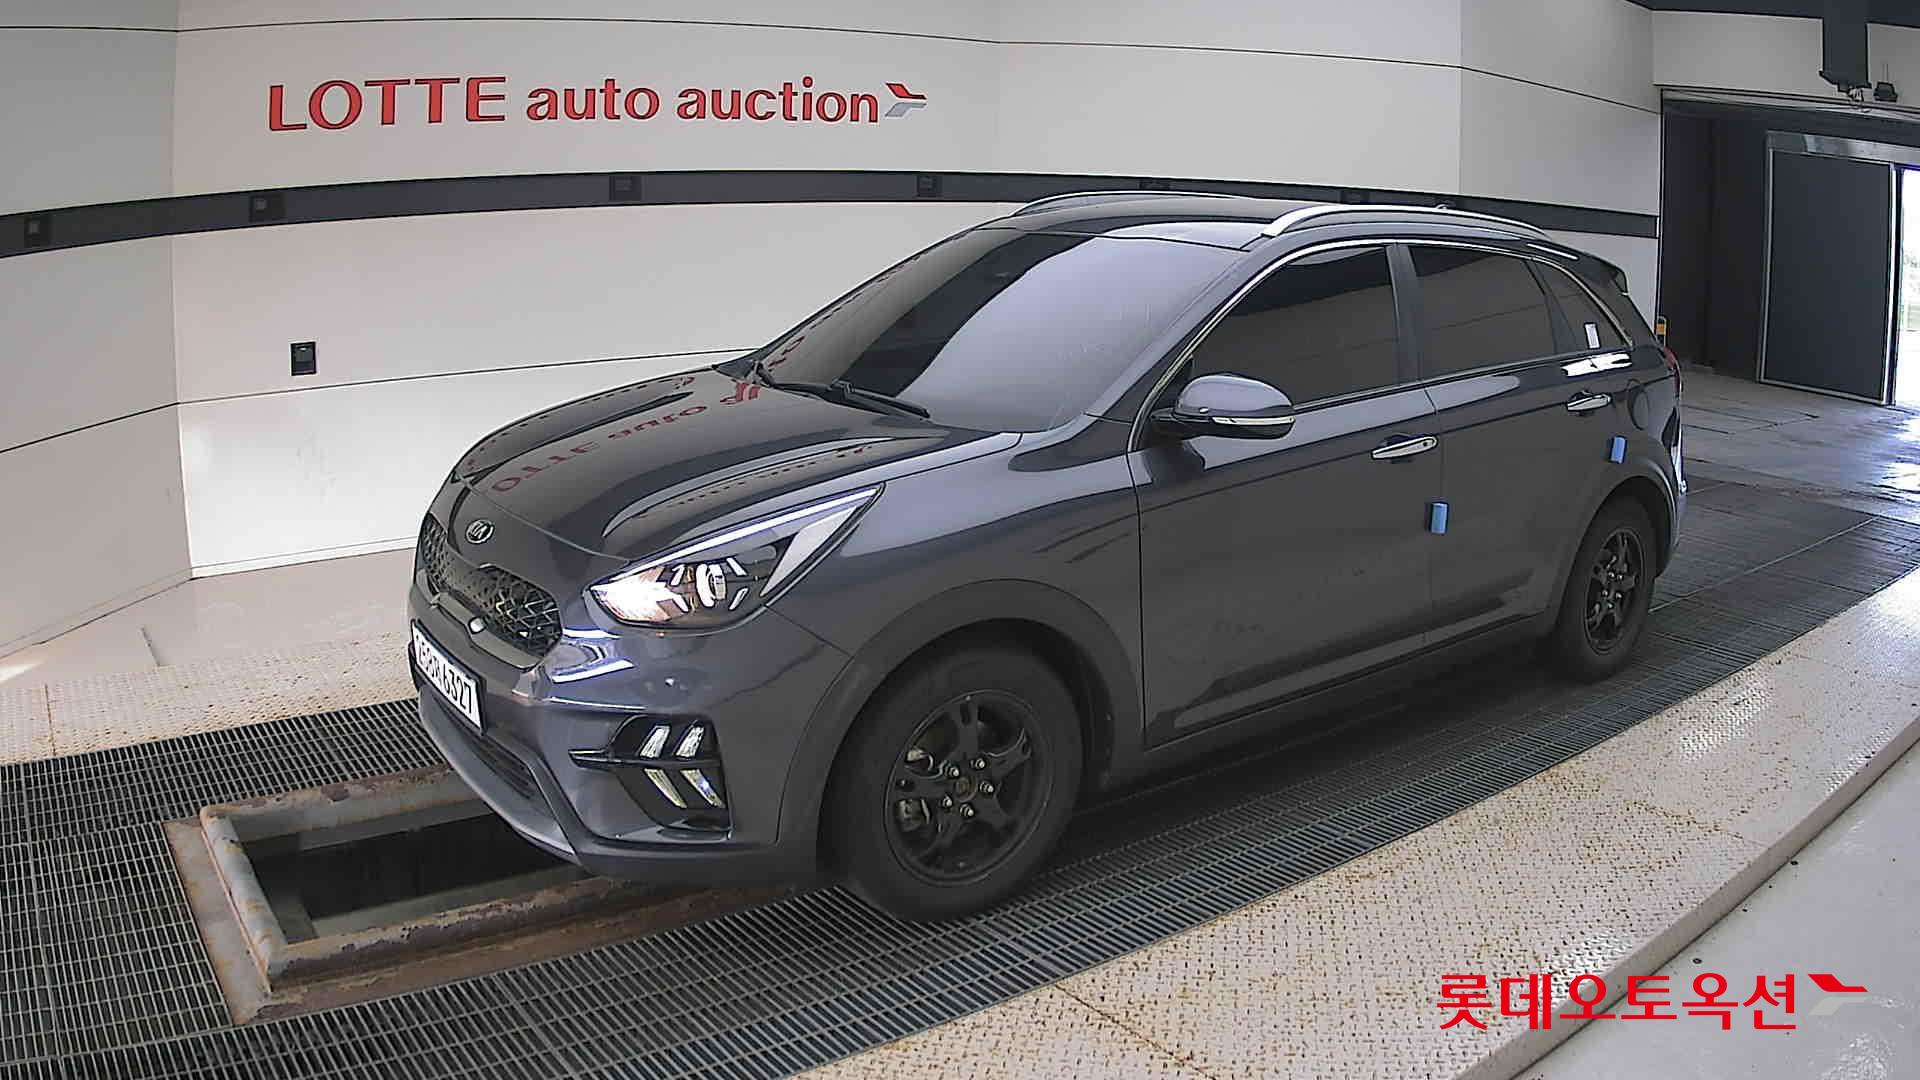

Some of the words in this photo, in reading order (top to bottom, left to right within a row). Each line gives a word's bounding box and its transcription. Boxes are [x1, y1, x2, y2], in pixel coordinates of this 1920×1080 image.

[268, 76, 505, 131] LOTTE
[526, 78, 660, 121] auto
[676, 76, 879, 123] auction
